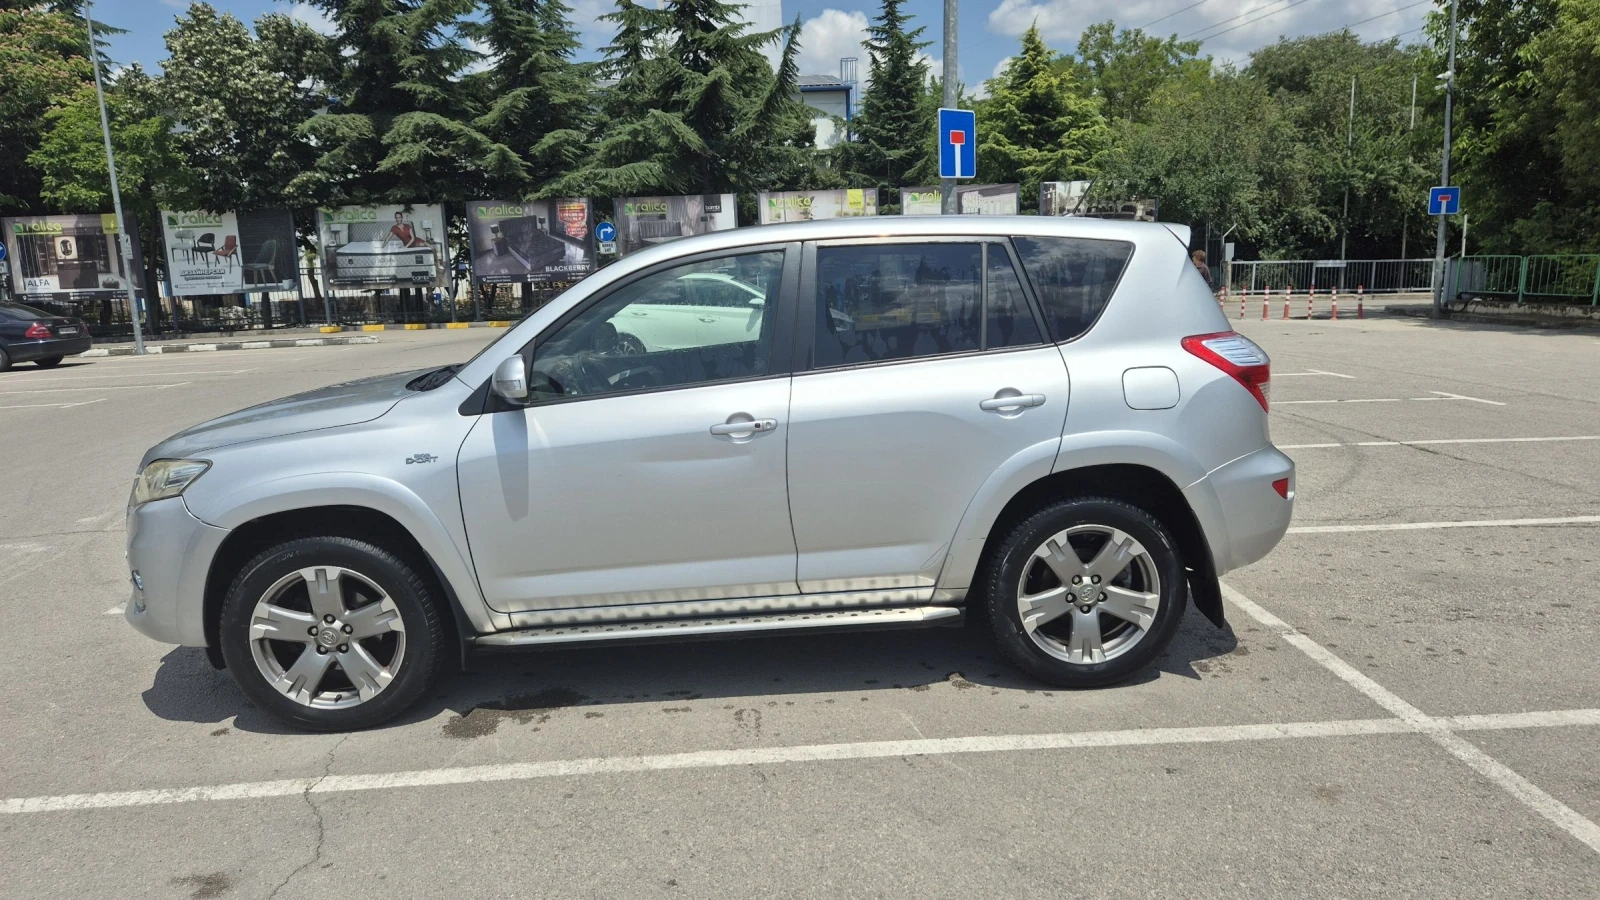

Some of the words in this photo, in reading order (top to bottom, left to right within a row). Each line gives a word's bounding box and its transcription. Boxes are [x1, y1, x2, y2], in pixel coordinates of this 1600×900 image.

[778, 195, 811, 206] ralica
[921, 189, 942, 201] rali
[488, 204, 523, 215] ralica
[635, 201, 668, 211] ralica
[181, 211, 223, 224] ralica
[338, 207, 377, 220] ralica
[26, 220, 62, 232] ralica
[180, 268, 225, 276] ДИЗАЙНЕРСКИ
[545, 264, 591, 273] BLACKBERRY
[27, 279, 51, 287] ALFA
